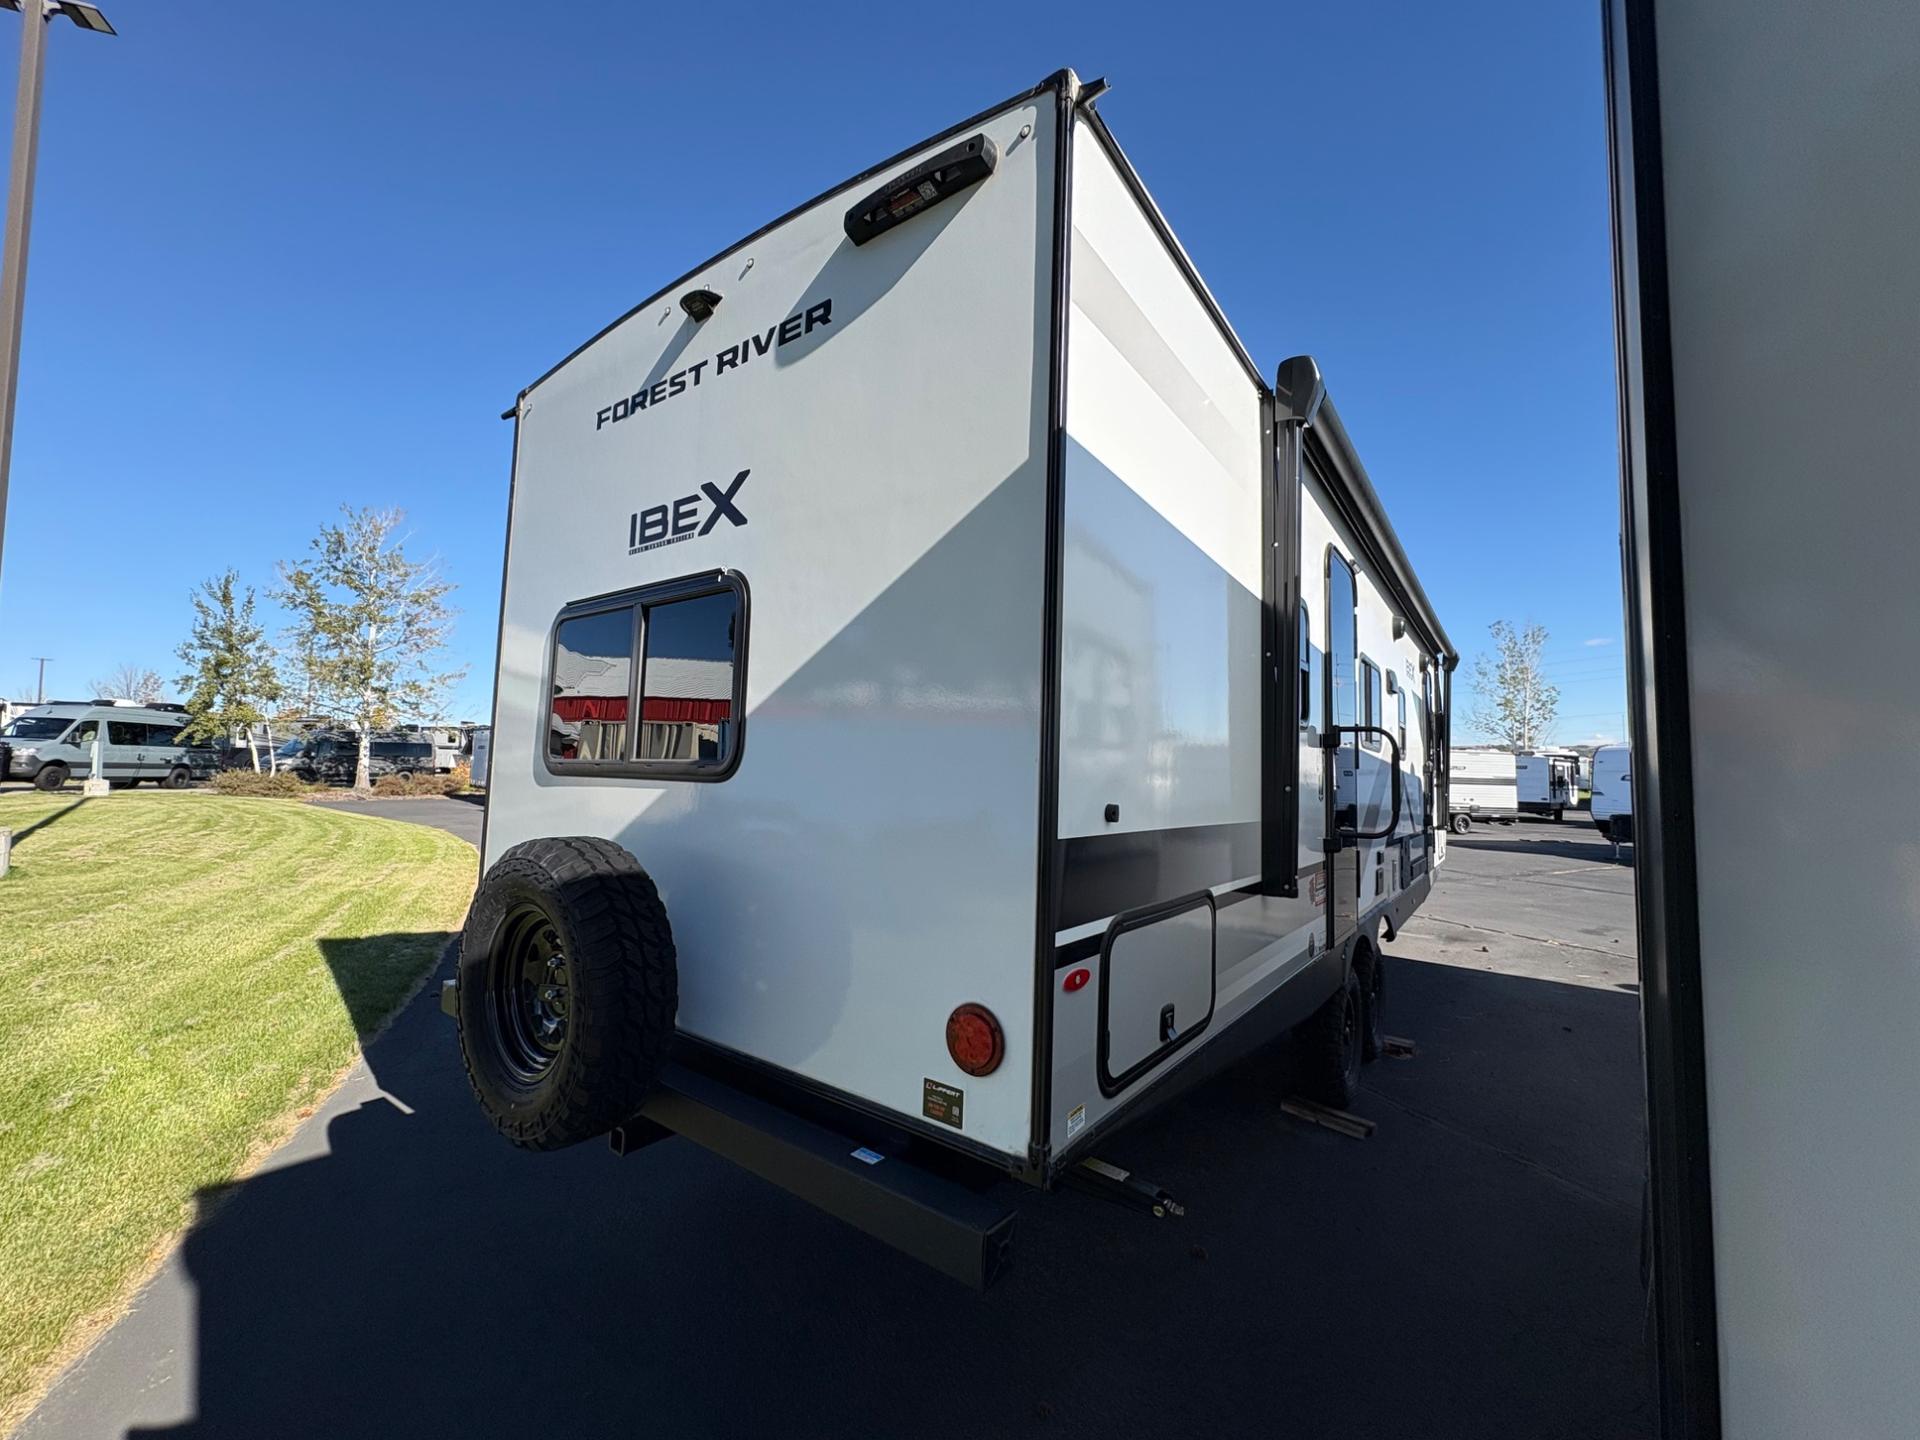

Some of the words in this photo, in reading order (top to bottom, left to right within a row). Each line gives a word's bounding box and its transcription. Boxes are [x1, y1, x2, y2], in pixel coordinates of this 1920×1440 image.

[596, 359, 708, 431] FOREST
[716, 298, 832, 376] RIVER
[629, 469, 750, 548] IBEX
